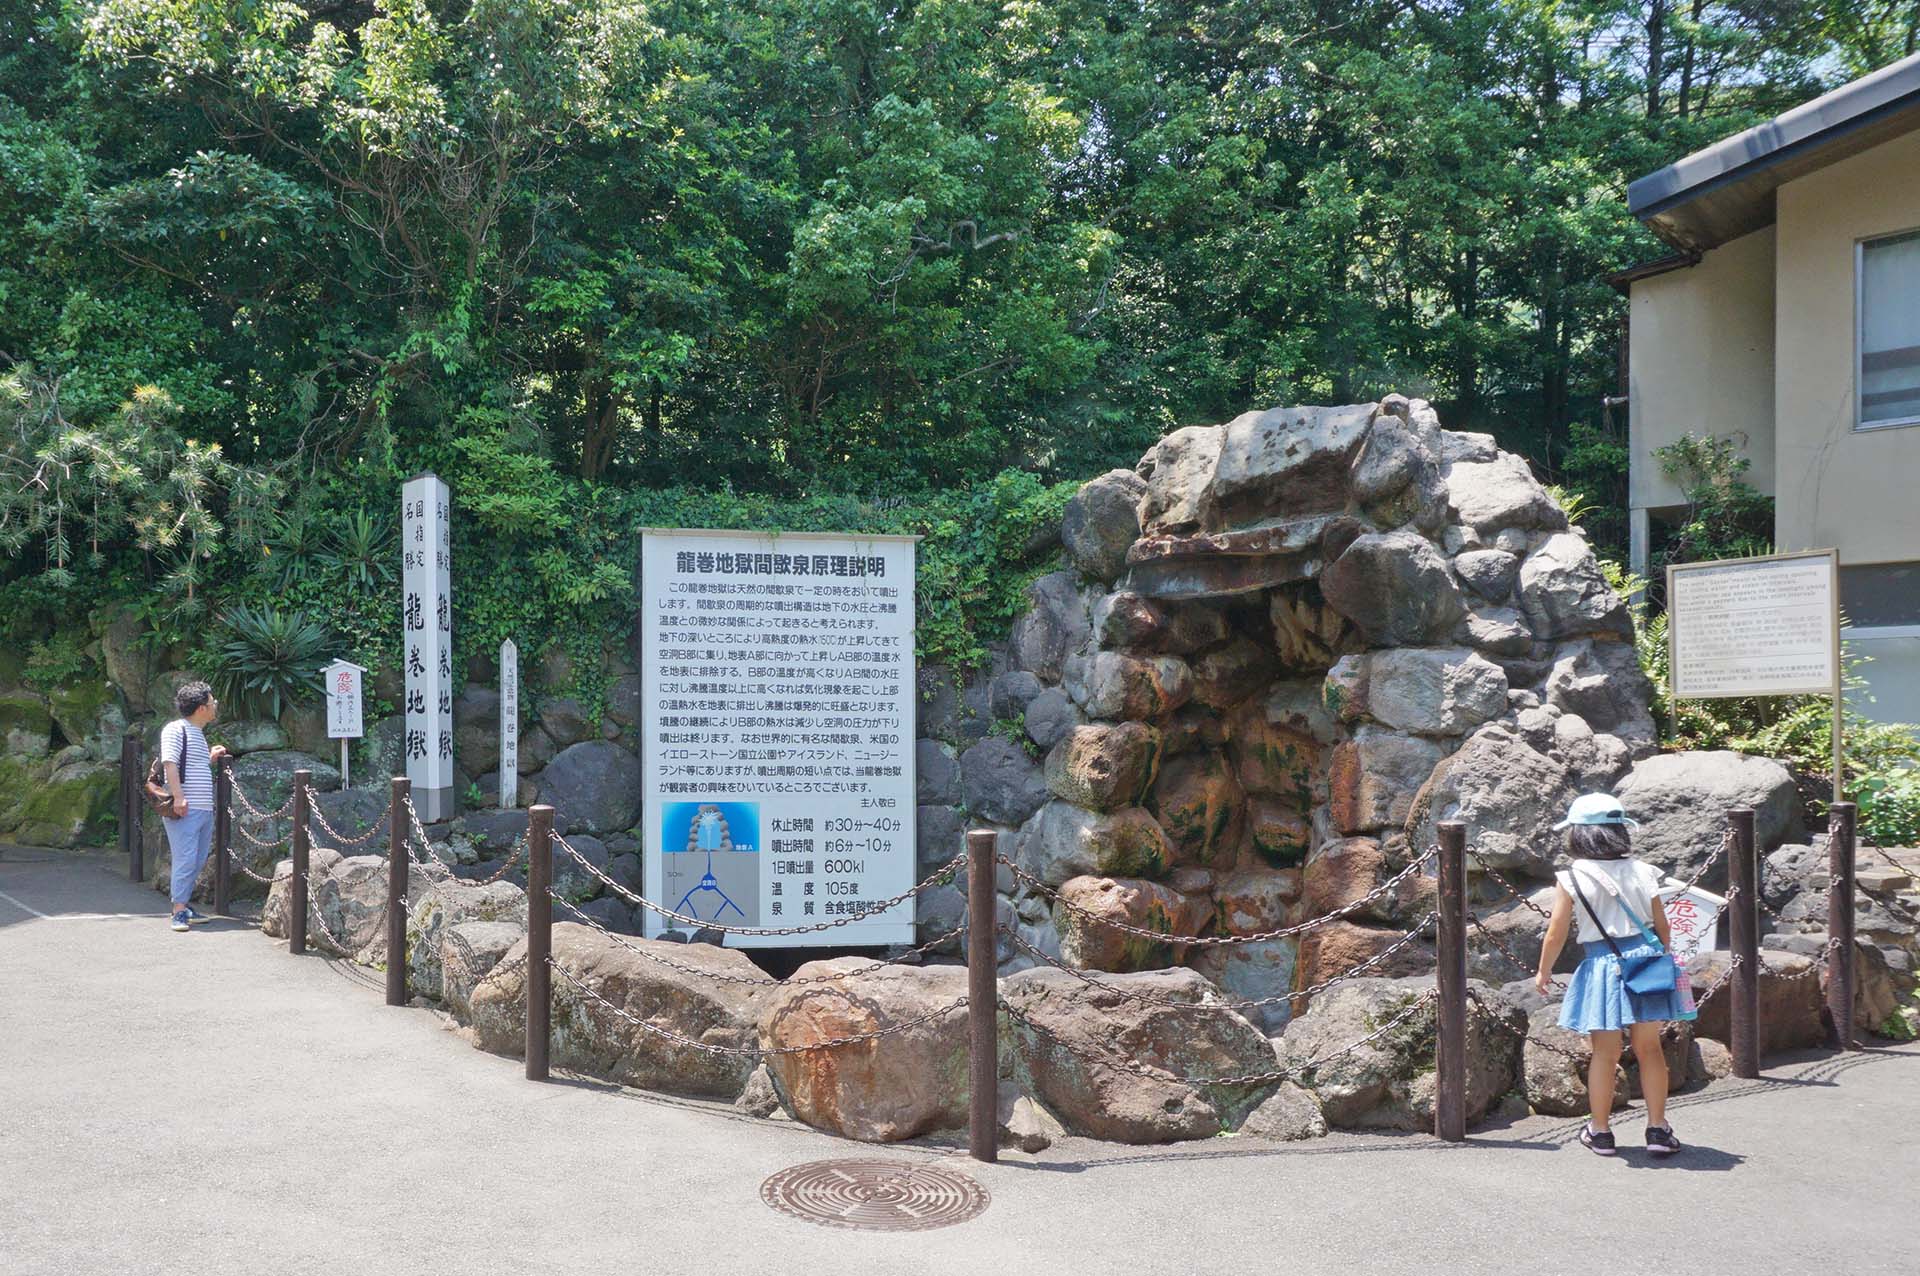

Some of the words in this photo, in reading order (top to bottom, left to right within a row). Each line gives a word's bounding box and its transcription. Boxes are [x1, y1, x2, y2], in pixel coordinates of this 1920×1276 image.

[772, 818, 814, 832] 休止時間
[772, 839, 814, 853] 噴出時間
[825, 882, 859, 895] 105度
